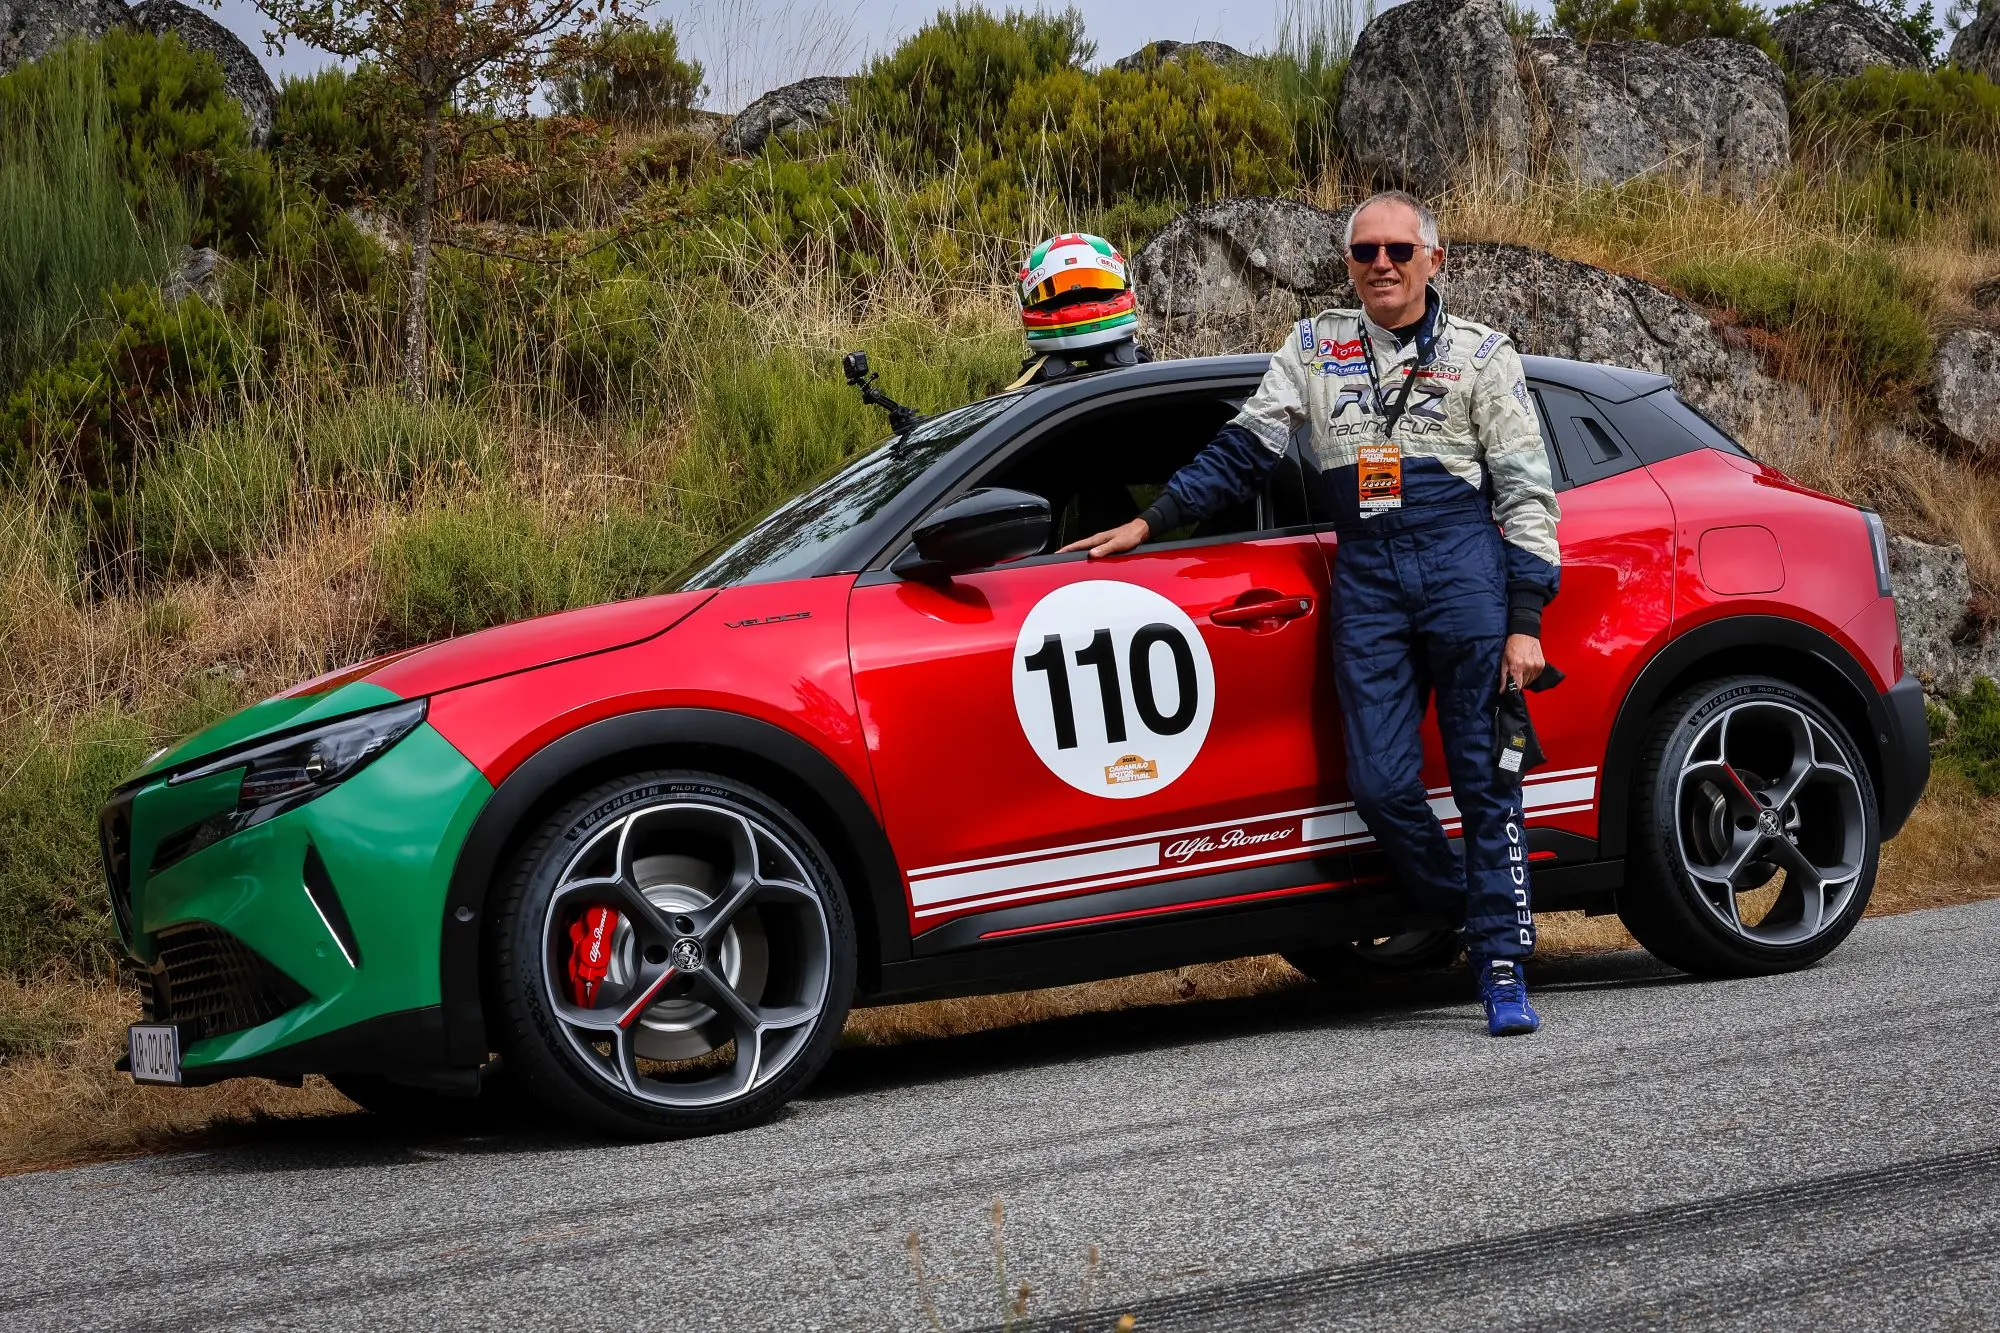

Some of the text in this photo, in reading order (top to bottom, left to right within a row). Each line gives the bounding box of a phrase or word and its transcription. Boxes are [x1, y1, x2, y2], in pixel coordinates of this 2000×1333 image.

[1101, 258, 1118, 271] BELL
[1027, 272, 1042, 288] BELL
[1335, 345, 1364, 358] TOTA
[1432, 373, 1462, 382] SPORT
[724, 611, 813, 628] VELOCE
[1024, 622, 1199, 750] 110
[1702, 686, 1798, 713] MICHELIN PILOT SPORT
[1108, 770, 1134, 779] MOTOR
[1109, 762, 1149, 773] CARAMULO
[1117, 773, 1151, 783] FESTIVAL
[584, 784, 729, 827] MICHELIN PILOT SPORT
[1164, 827, 1295, 864] Alfa Romeo
[589, 907, 608, 963] Alfa Romeo
